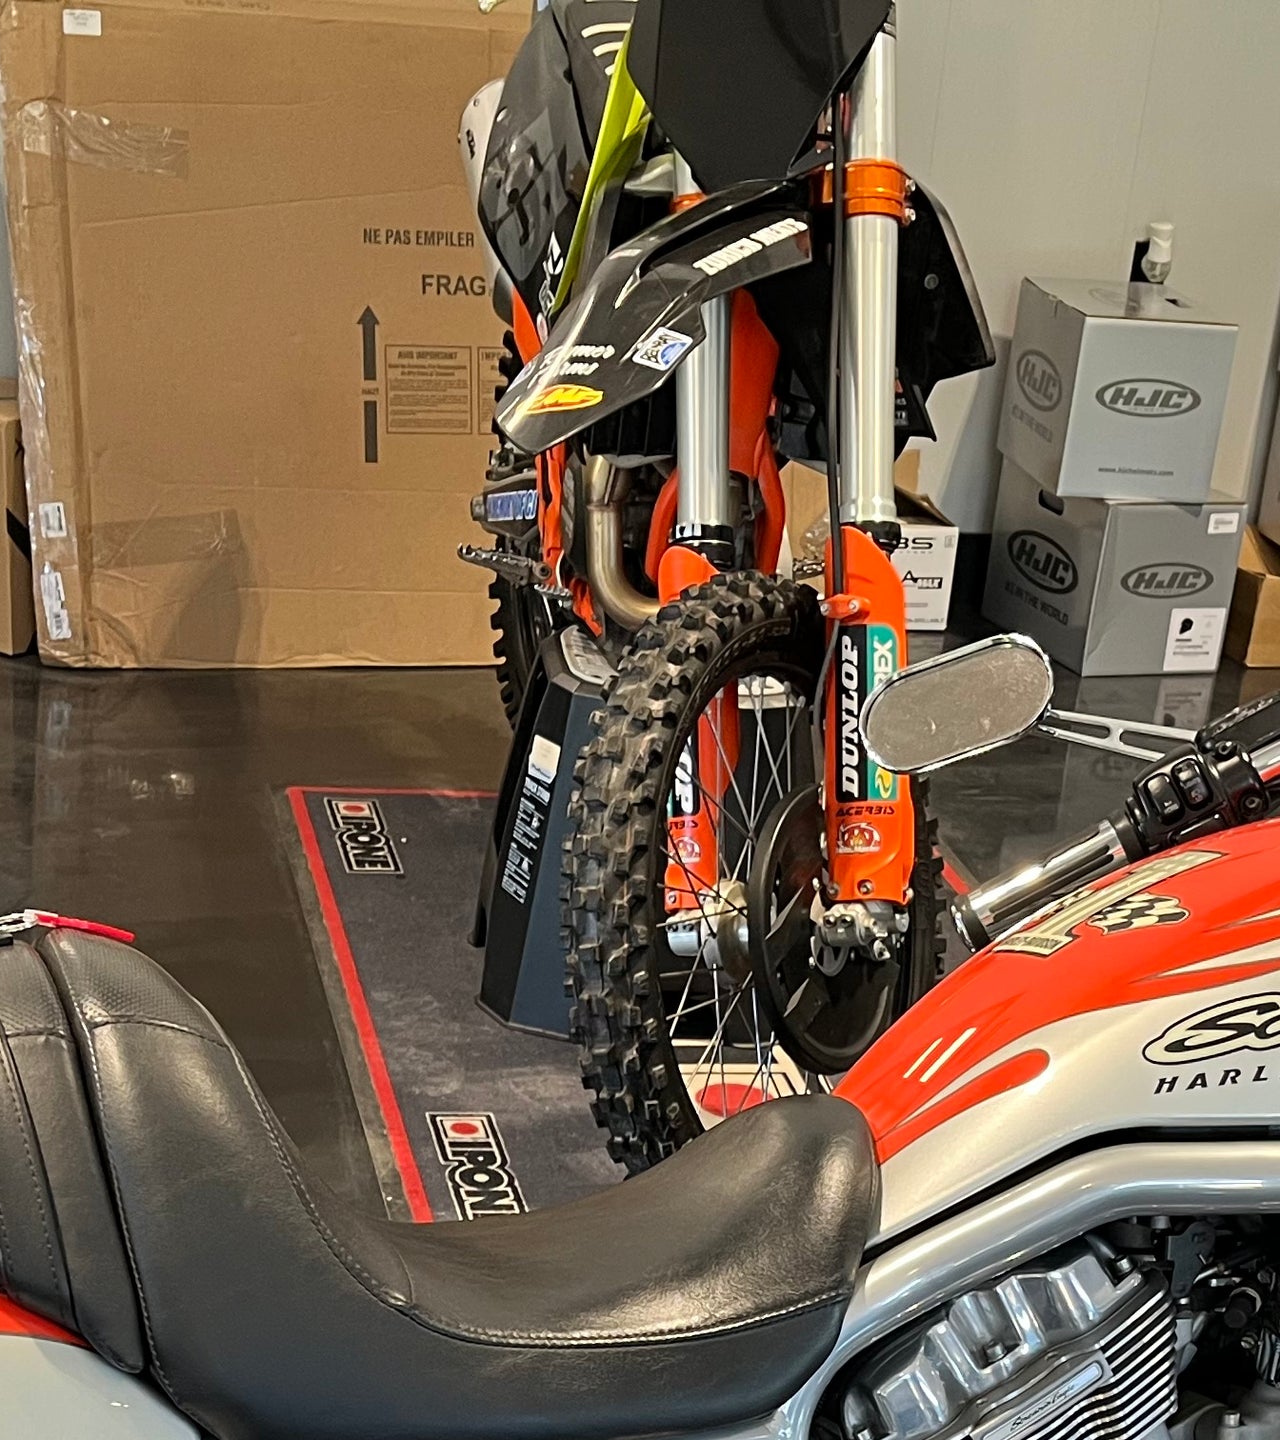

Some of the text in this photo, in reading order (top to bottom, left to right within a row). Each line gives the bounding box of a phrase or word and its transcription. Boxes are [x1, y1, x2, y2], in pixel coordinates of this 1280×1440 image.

[363, 228, 474, 247] NE PAS EMPILER
[421, 274, 487, 297] FRAG
[1108, 387, 1188, 410] HJC
[1019, 539, 1072, 586] HJC
[1131, 571, 1204, 590] HJC
[841, 635, 859, 798] DUNLOP
[836, 805, 896, 817] ACERBIS
